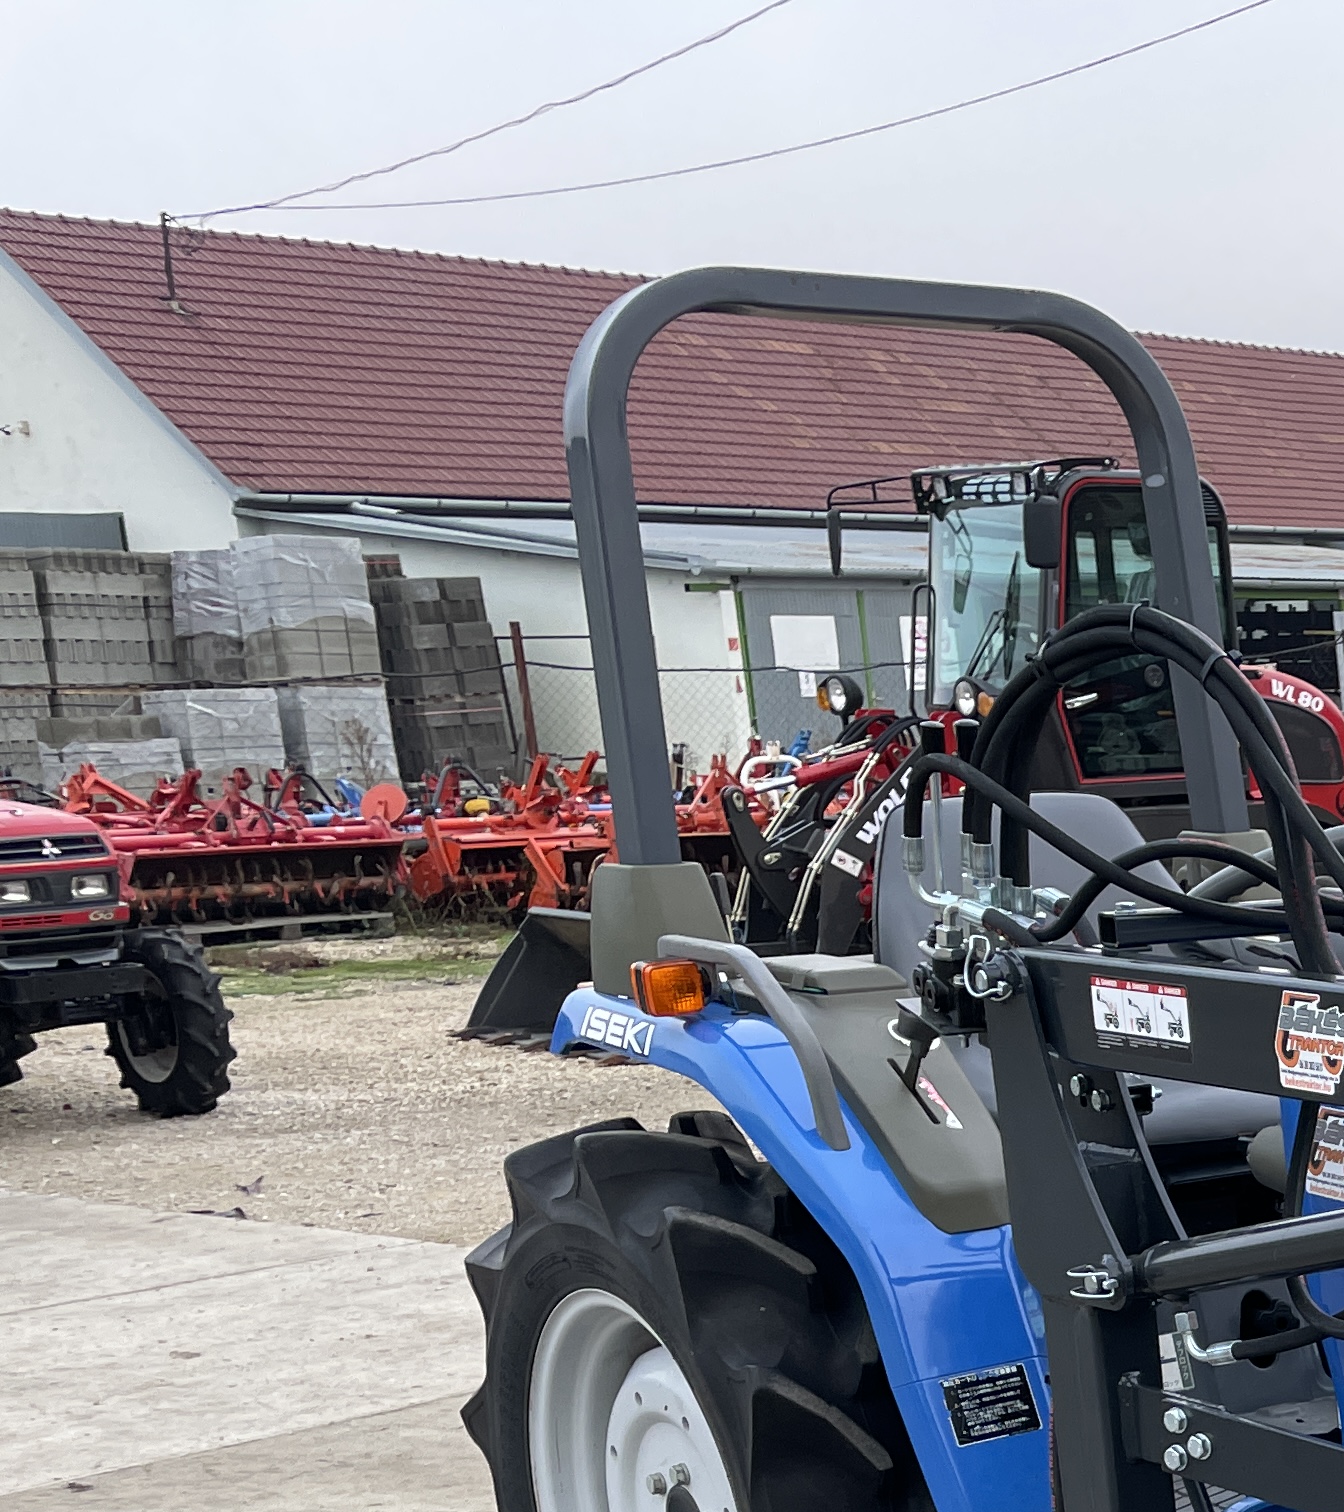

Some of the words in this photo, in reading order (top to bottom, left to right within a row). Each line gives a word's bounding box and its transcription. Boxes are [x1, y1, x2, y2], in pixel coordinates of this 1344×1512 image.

[1271, 678, 1296, 703] WL
[1297, 691, 1325, 712] 80
[580, 1006, 656, 1056] ISEKI
